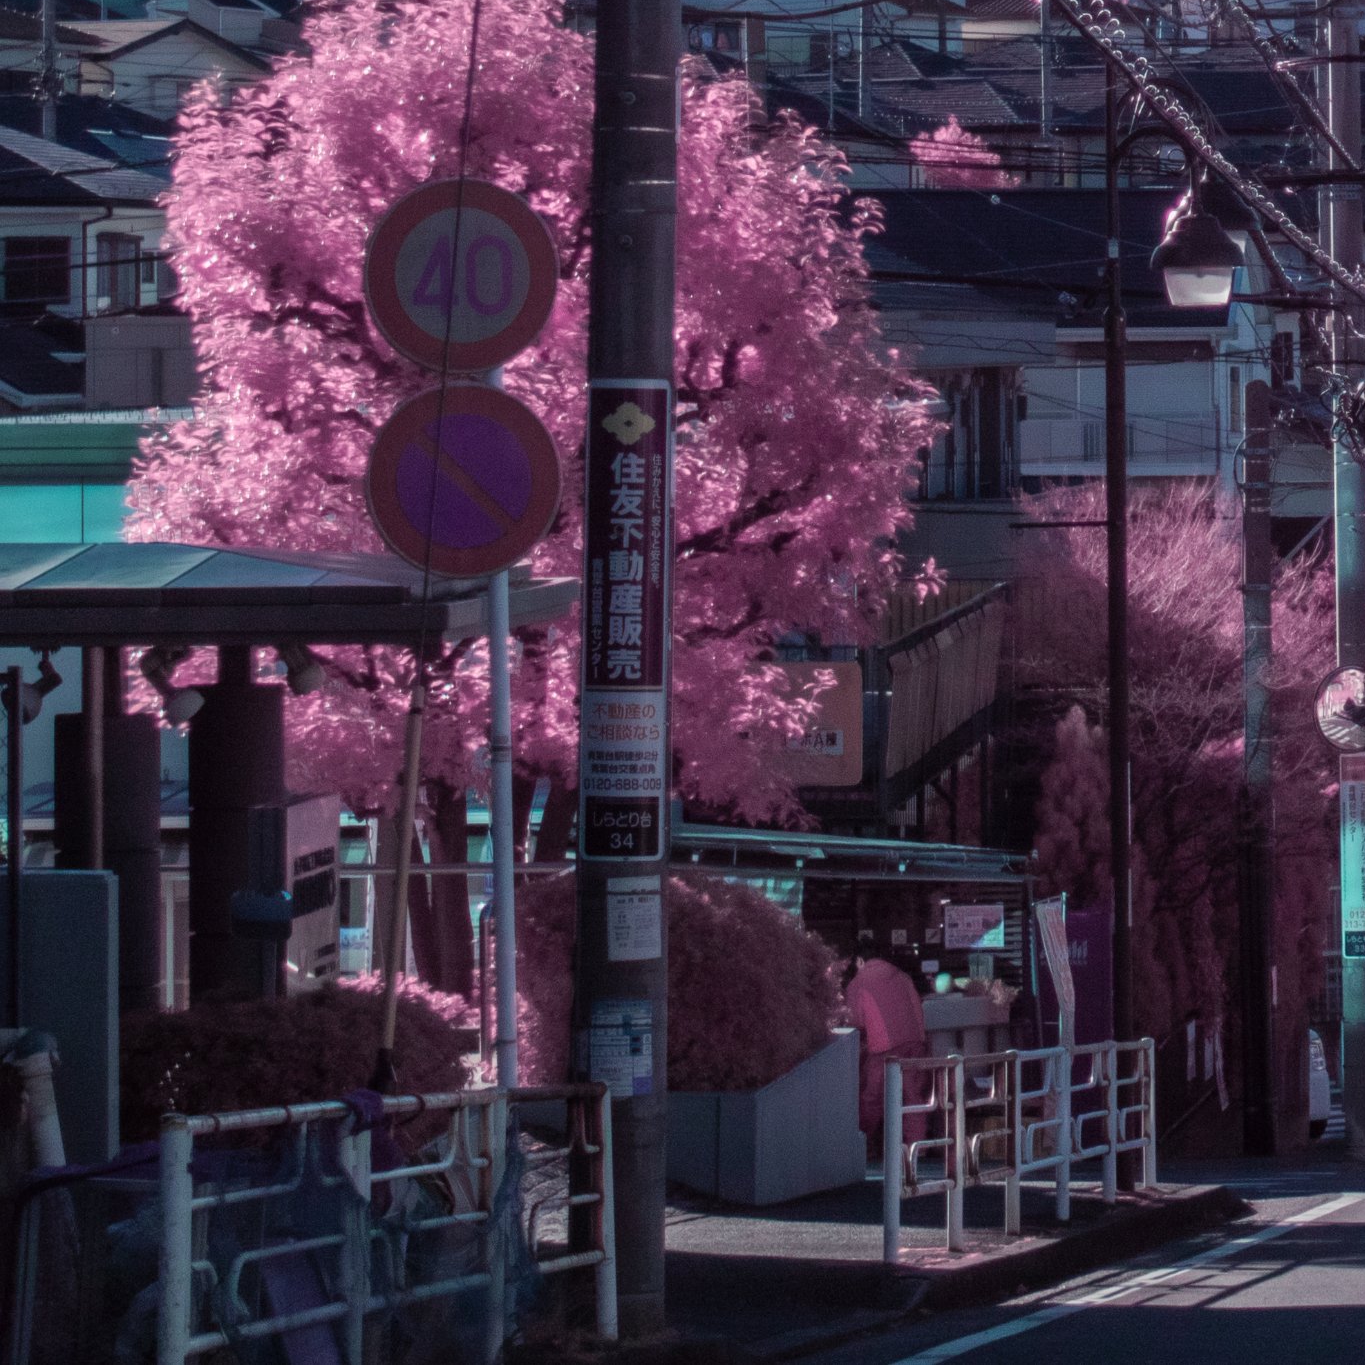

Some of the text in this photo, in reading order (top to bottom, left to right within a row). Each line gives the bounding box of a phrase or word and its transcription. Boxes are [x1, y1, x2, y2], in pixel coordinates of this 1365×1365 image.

[412, 235, 515, 317] 40
[607, 452, 646, 680] 住友不動産販売
[592, 703, 656, 719] 不動産の
[587, 724, 660, 741] ご相談なら
[593, 811, 652, 827] しらとり台
[610, 833, 634, 849] 34
